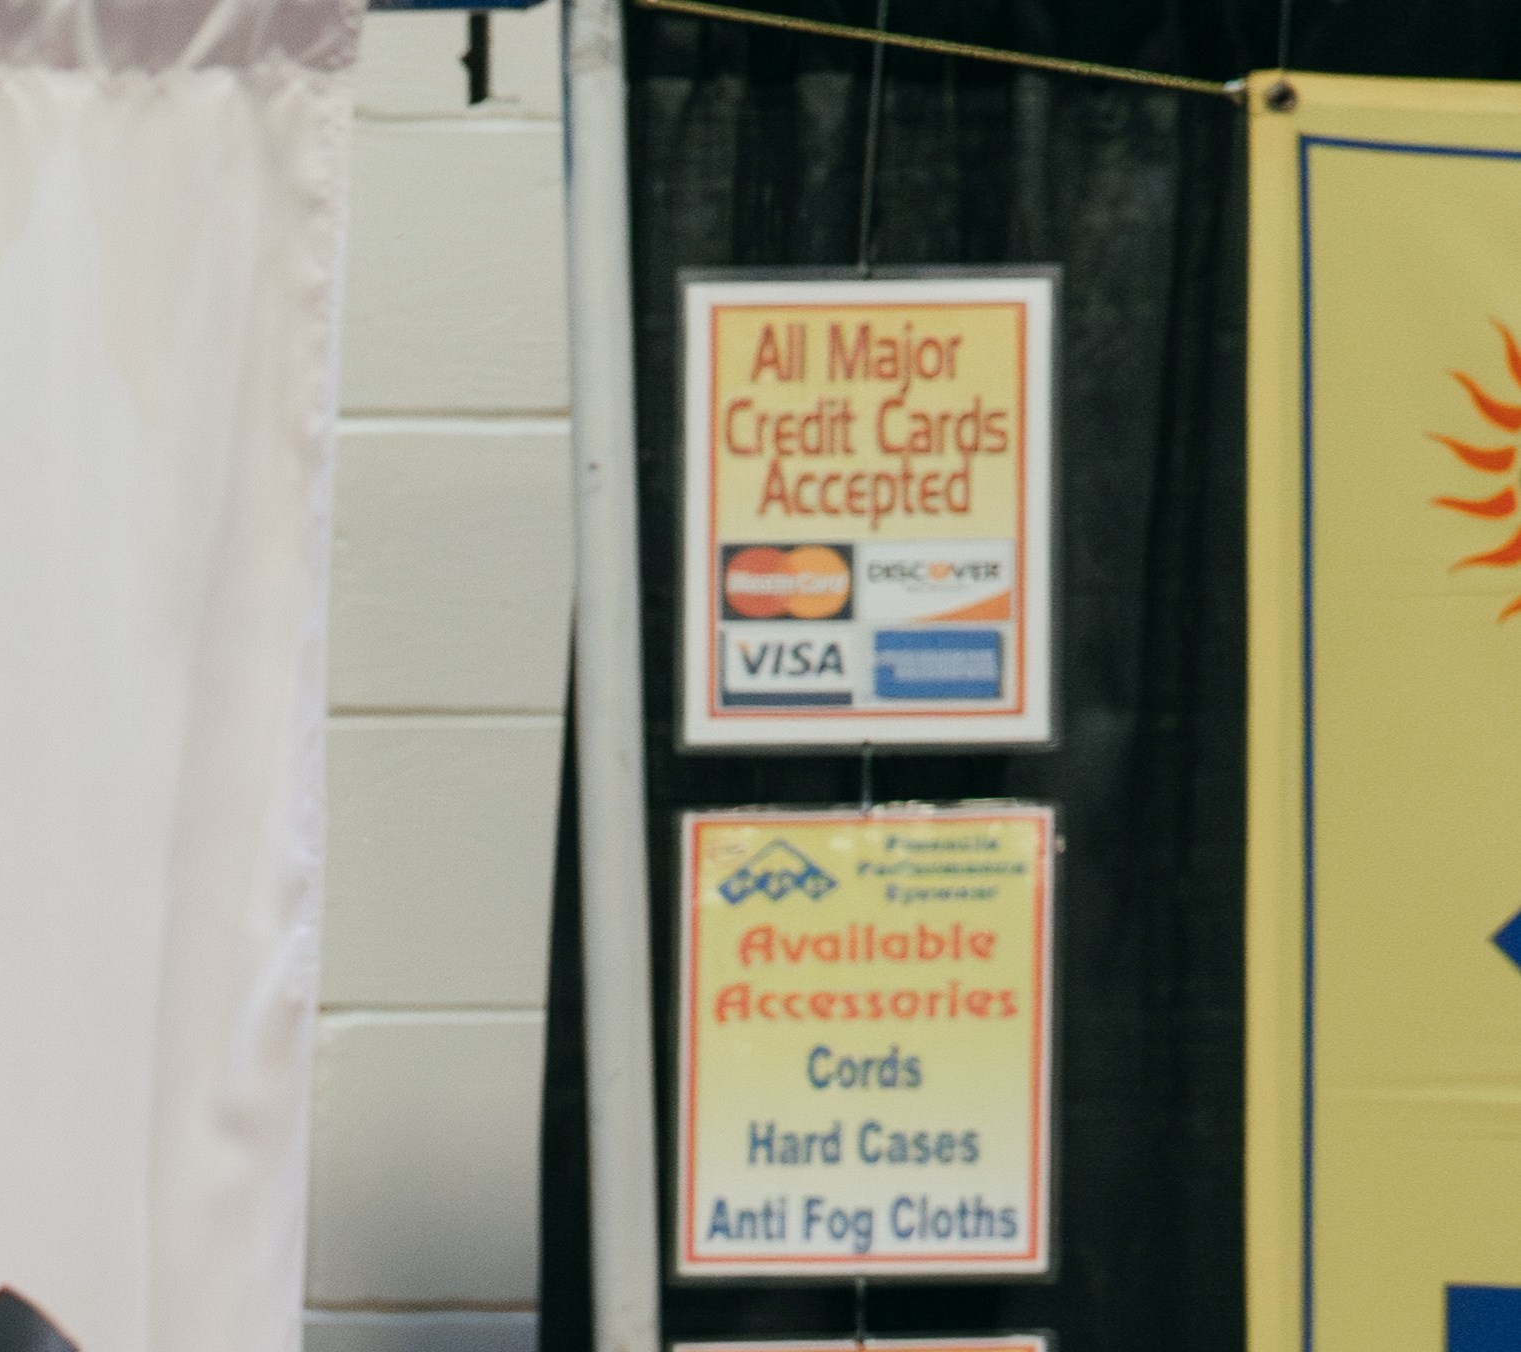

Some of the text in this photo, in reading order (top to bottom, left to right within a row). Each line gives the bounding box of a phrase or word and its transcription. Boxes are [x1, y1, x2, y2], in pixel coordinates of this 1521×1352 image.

[749, 321, 964, 398] All Major
[724, 396, 1009, 458] Credit Cards
[756, 455, 973, 531] Accepted
[740, 641, 845, 676] VISA
[737, 921, 998, 967] Available
[713, 981, 1019, 1025] Accessories
[806, 1044, 923, 1091] Cords
[747, 1120, 980, 1167] Hard Cases
[706, 1195, 1019, 1254] Anti Fog Cloths
